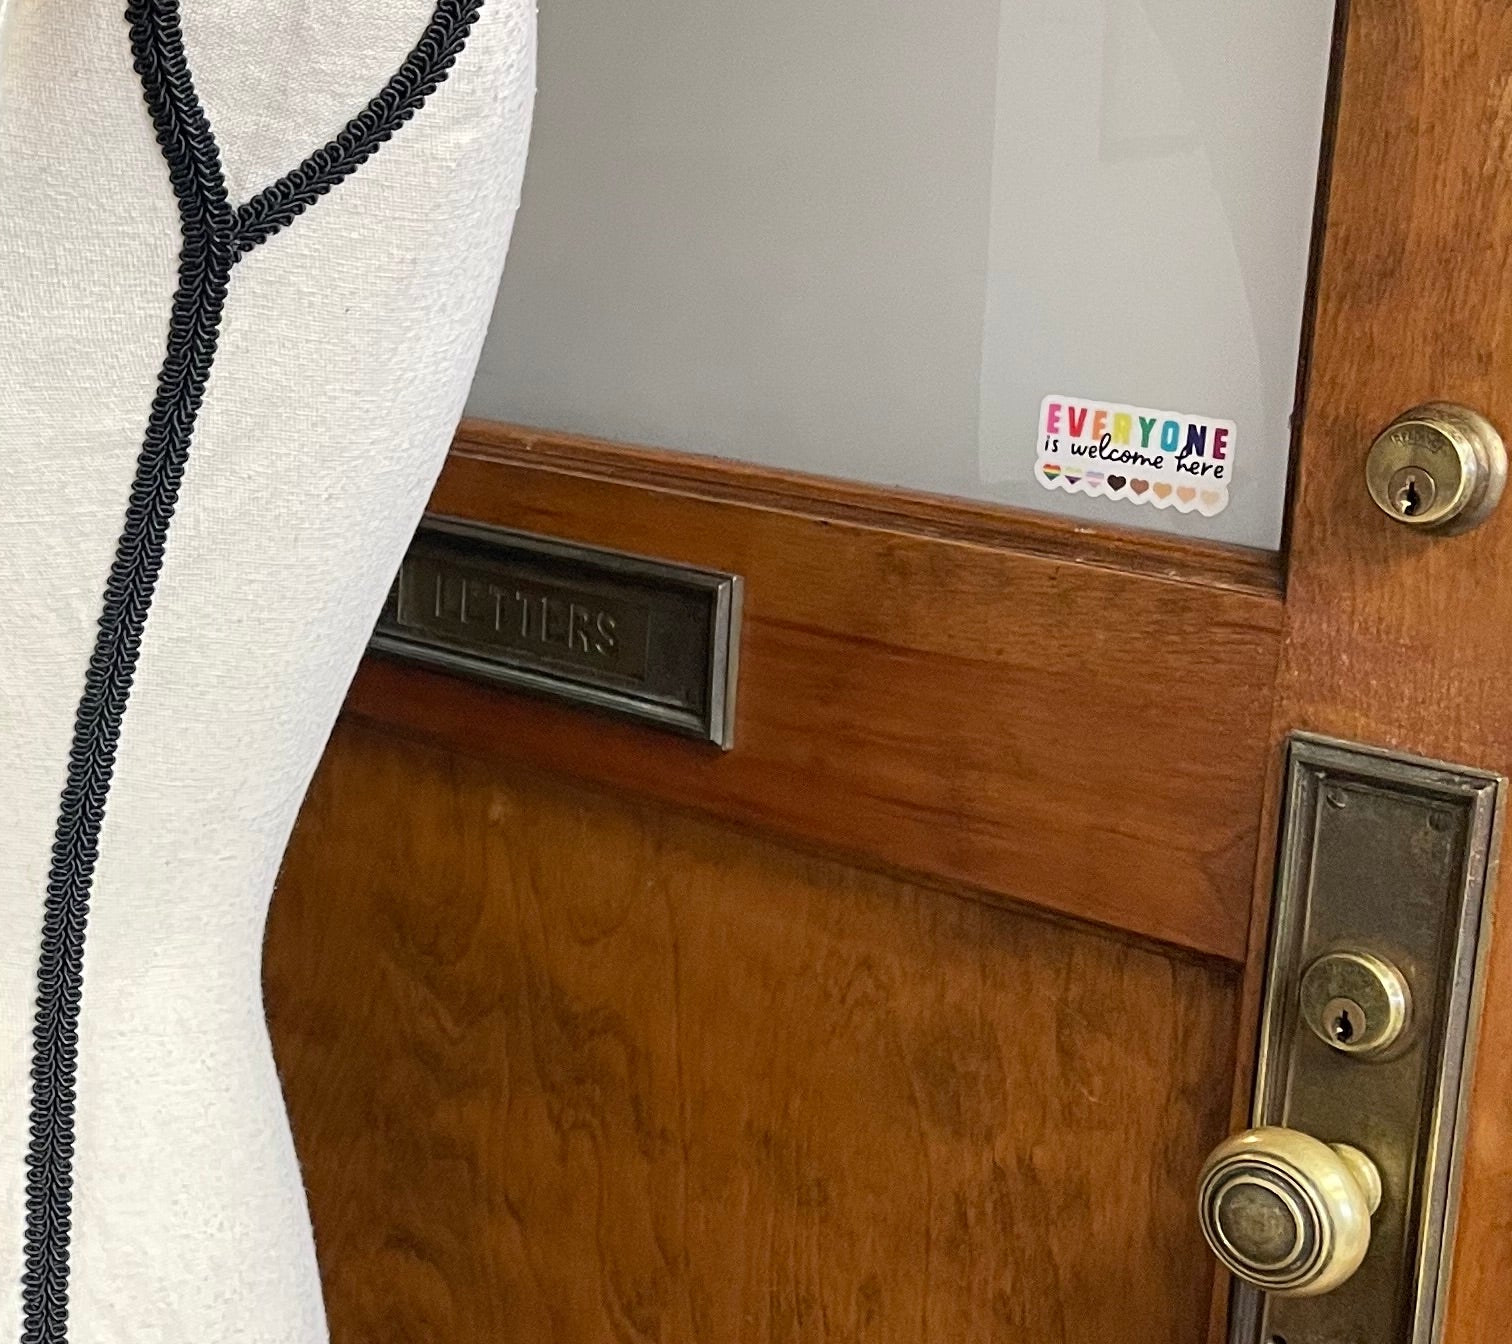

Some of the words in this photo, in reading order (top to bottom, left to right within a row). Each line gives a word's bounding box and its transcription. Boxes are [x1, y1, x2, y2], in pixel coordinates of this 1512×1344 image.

[1044, 435, 1059, 453] is
[1071, 433, 1164, 470] welcome
[1174, 442, 1225, 479] here
[1046, 403, 1229, 460] EVERYONE
